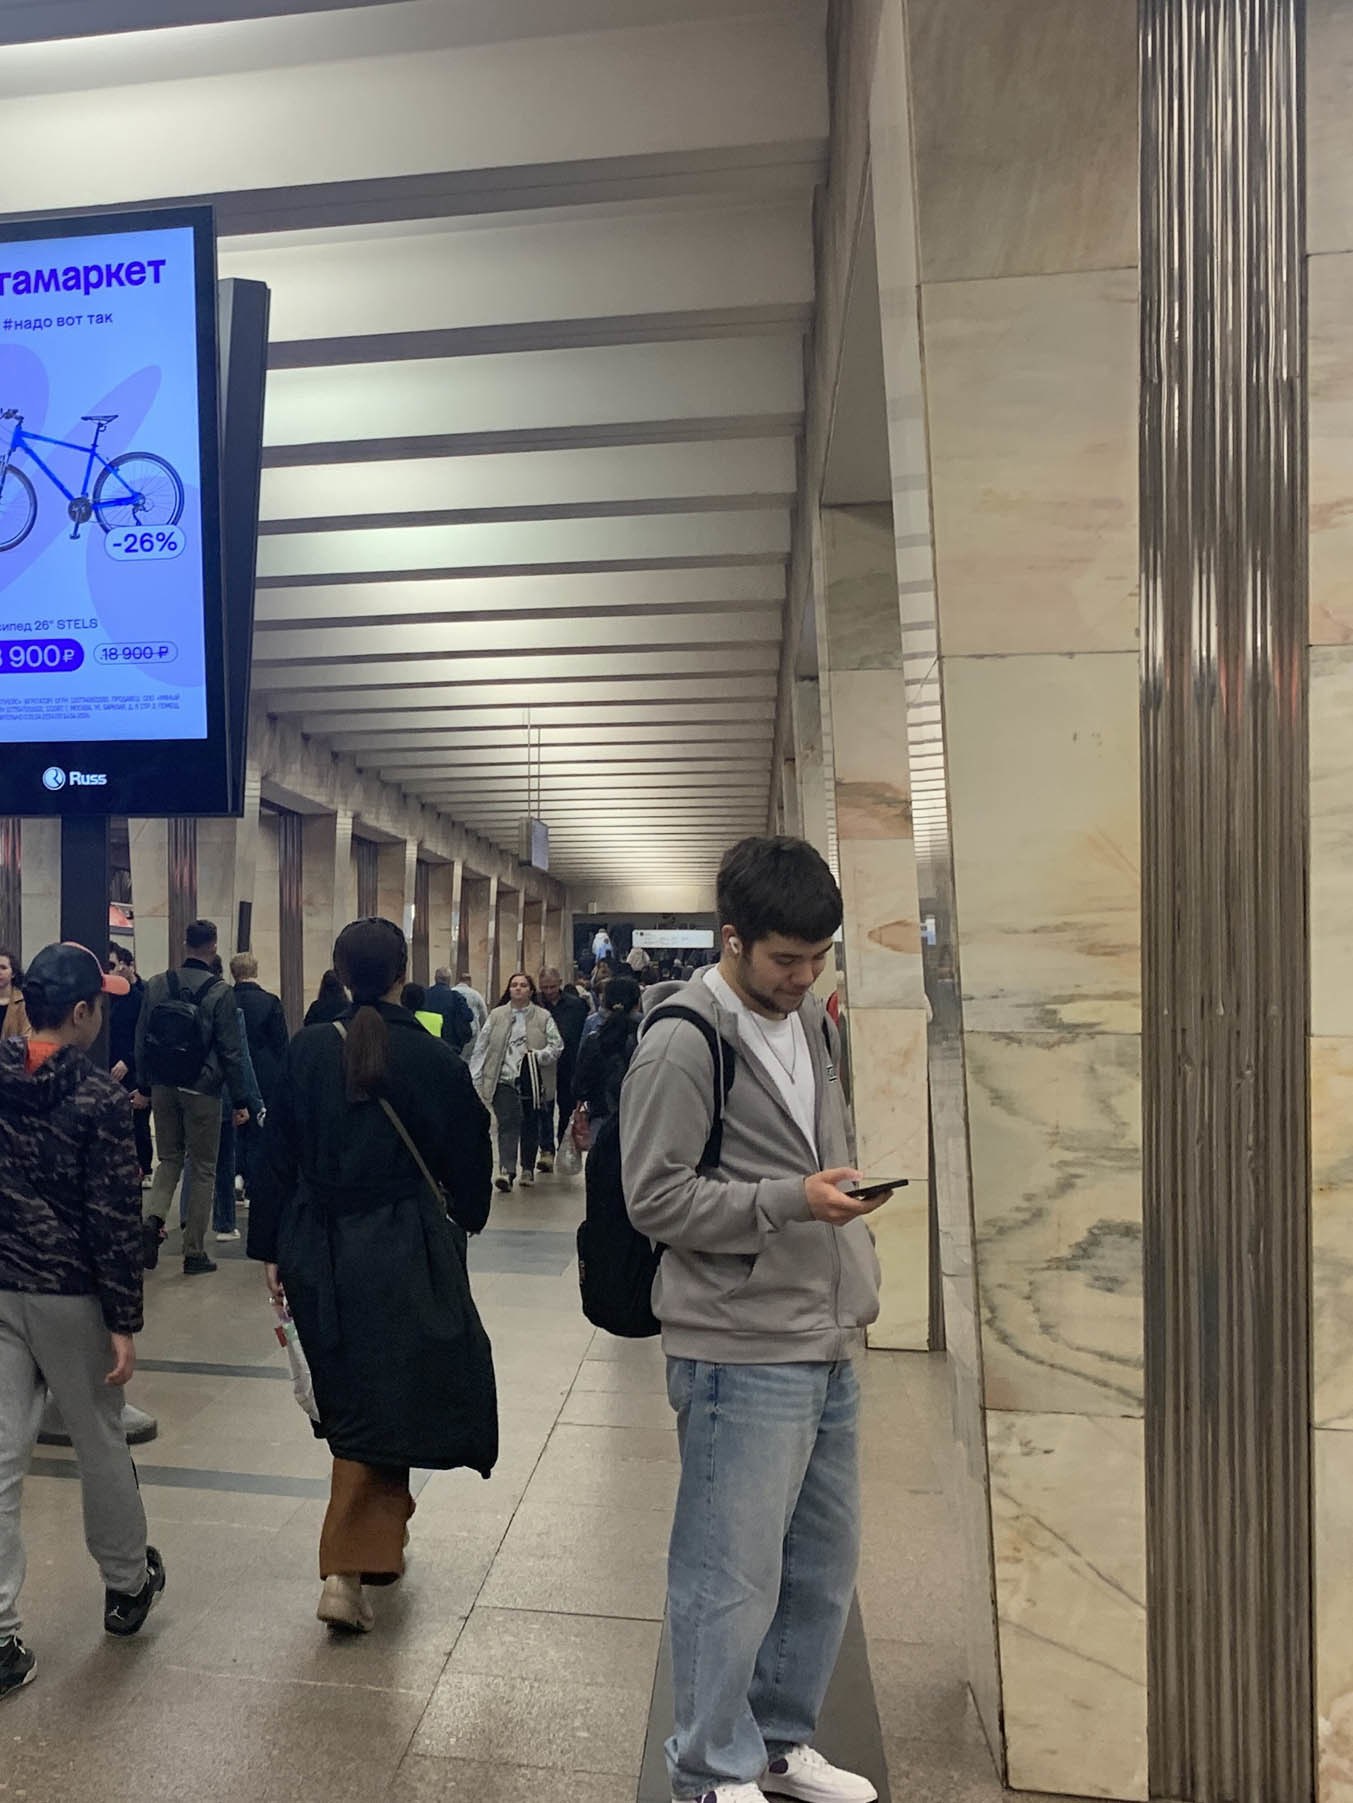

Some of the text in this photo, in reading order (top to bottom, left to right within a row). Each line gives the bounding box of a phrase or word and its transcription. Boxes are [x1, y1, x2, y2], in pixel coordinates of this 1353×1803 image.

[3, 313, 113, 331] #надо вот так
[113, 531, 178, 553] -26%
[57, 618, 99, 630] STELS
[69, 771, 107, 785] Russ
